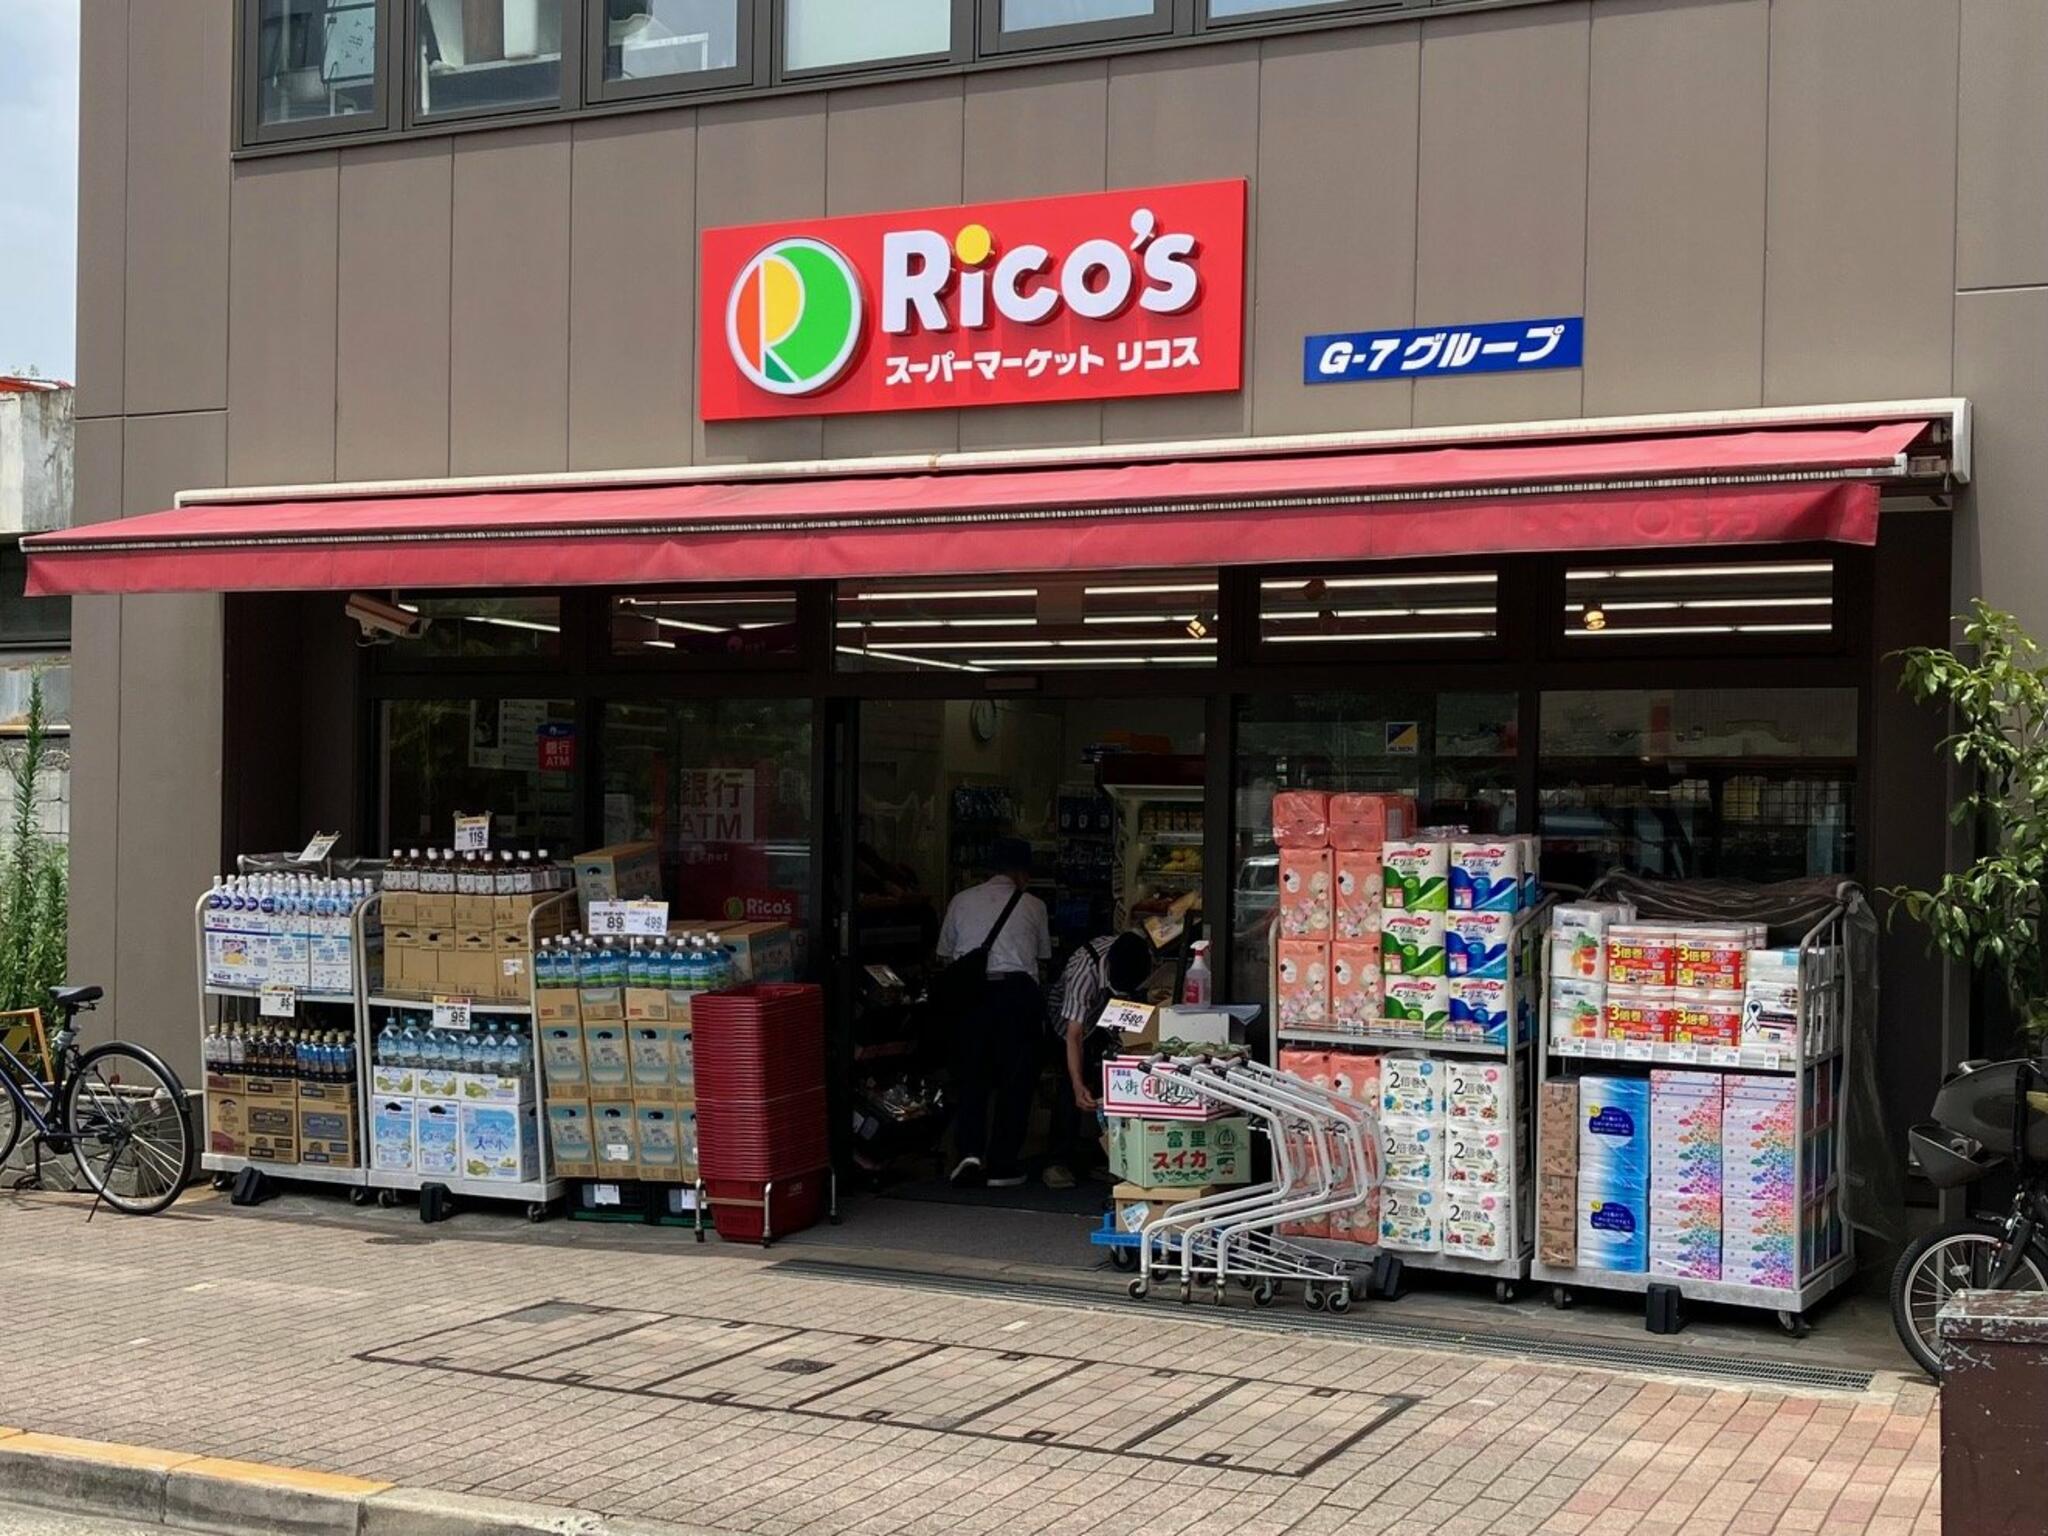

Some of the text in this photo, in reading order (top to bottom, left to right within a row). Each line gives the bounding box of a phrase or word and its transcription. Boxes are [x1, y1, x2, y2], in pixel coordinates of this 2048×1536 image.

[882, 208, 1197, 333] Rico's
[1317, 323, 1566, 375] G-7グループ
[885, 336, 1200, 385] スーパーマーケット リコス
[544, 740, 571, 756] 銀行
[545, 756, 570, 768] ATM
[680, 771, 744, 808] 銀行
[682, 813, 743, 840] ATM
[469, 831, 484, 843] 119
[746, 897, 793, 915] Rico's
[607, 916, 624, 929] 89
[644, 916, 662, 929] 499
[451, 1011, 466, 1022] 95
[1112, 1078, 1139, 1095] 八街
[1166, 1130, 1206, 1148] 富里
[1152, 1149, 1207, 1170] スイカ
